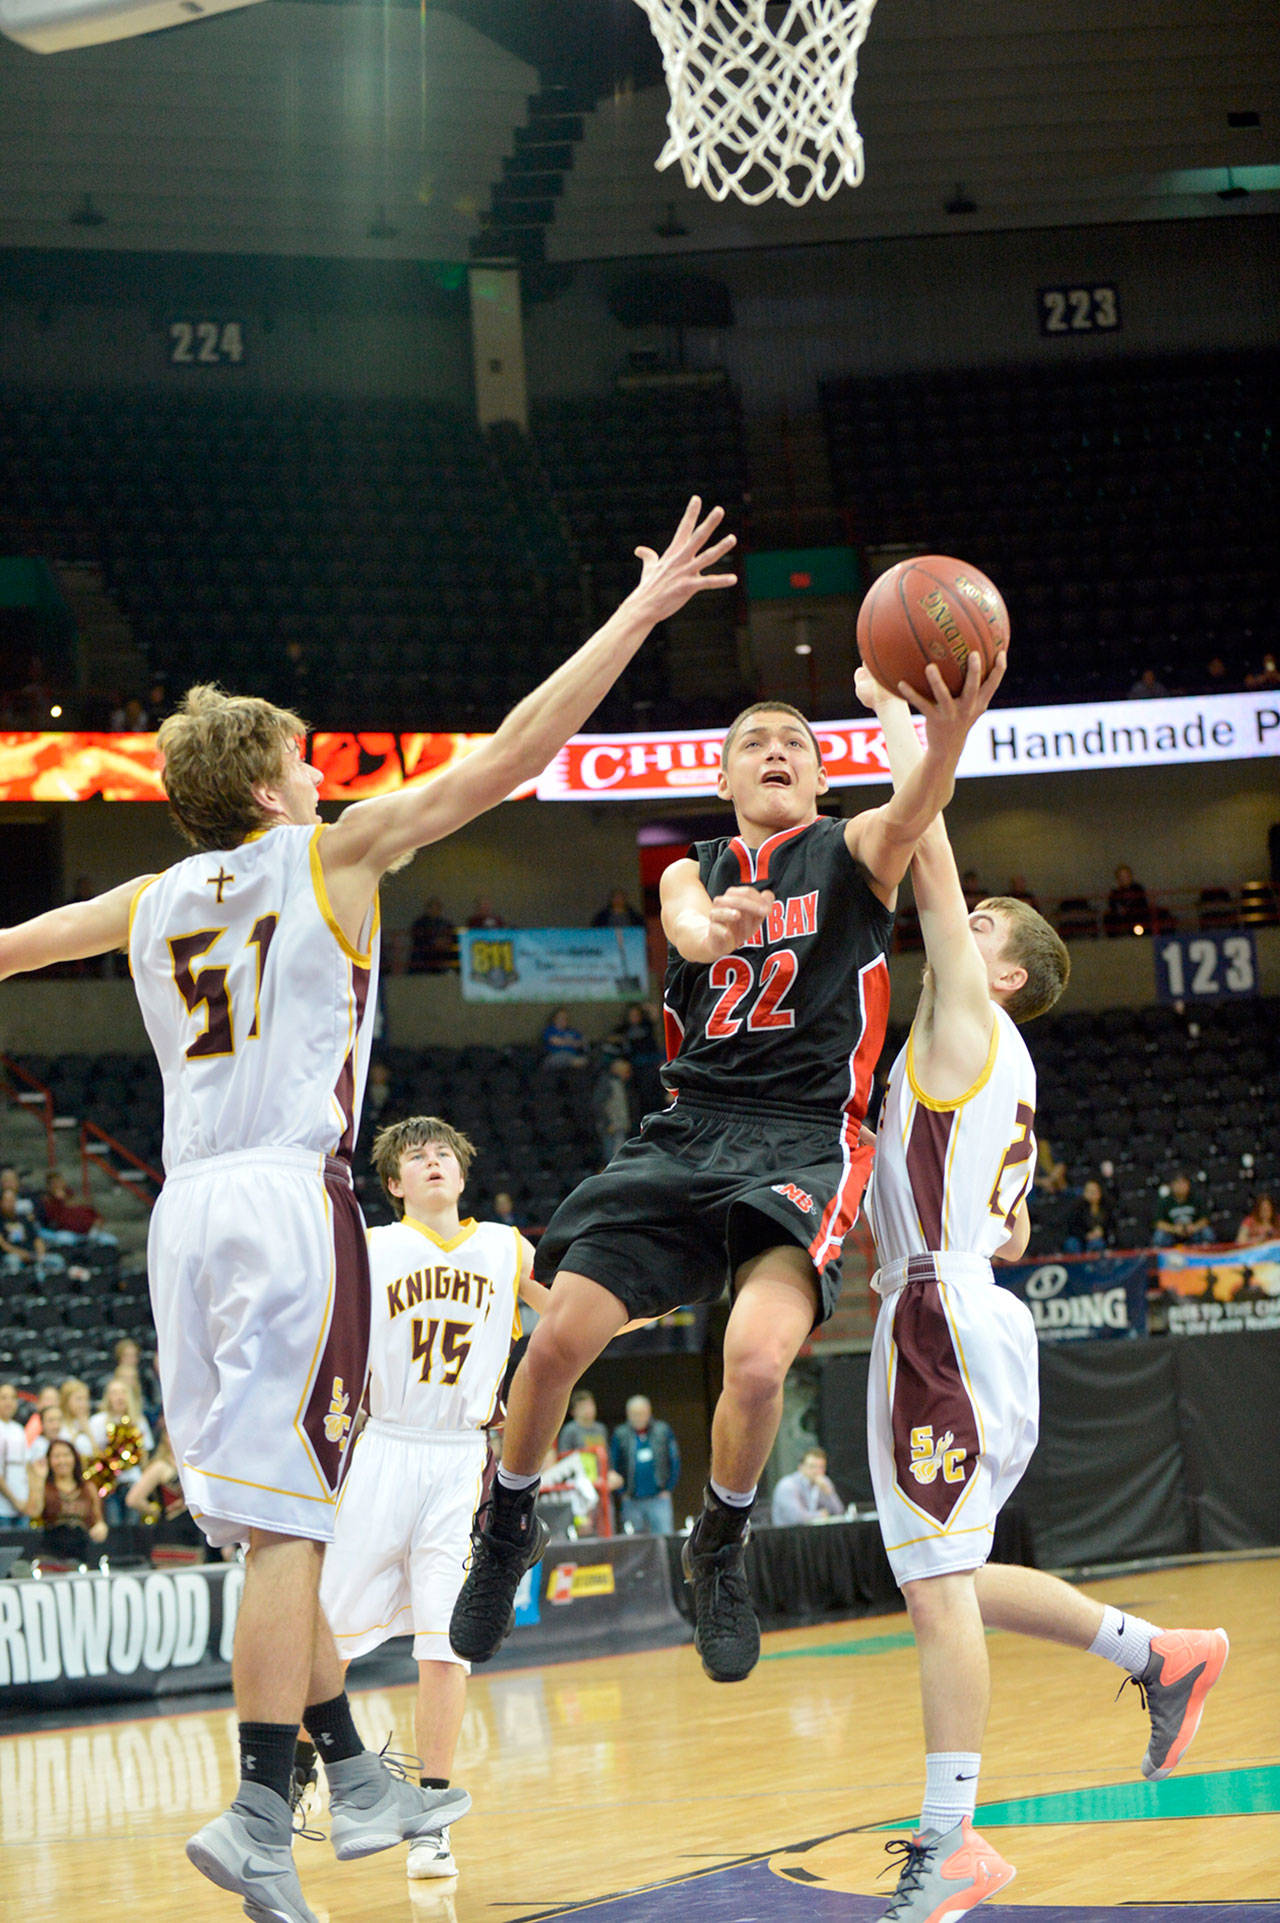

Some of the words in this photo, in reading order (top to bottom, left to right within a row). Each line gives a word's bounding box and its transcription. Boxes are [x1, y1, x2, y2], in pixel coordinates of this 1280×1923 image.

[169, 321, 243, 362] 224
[1043, 287, 1117, 331] 223
[918, 589, 970, 674] ALDING
[990, 685, 1234, 761] Handmade
[766, 889, 819, 944] BAY
[166, 911, 280, 1062] 51
[705, 948, 799, 1040] 22
[1162, 936, 1254, 996] 123
[1031, 1287, 1128, 1330] LDING
[411, 1317, 475, 1386] 45
[0, 1572, 211, 1687] RDWOOD
